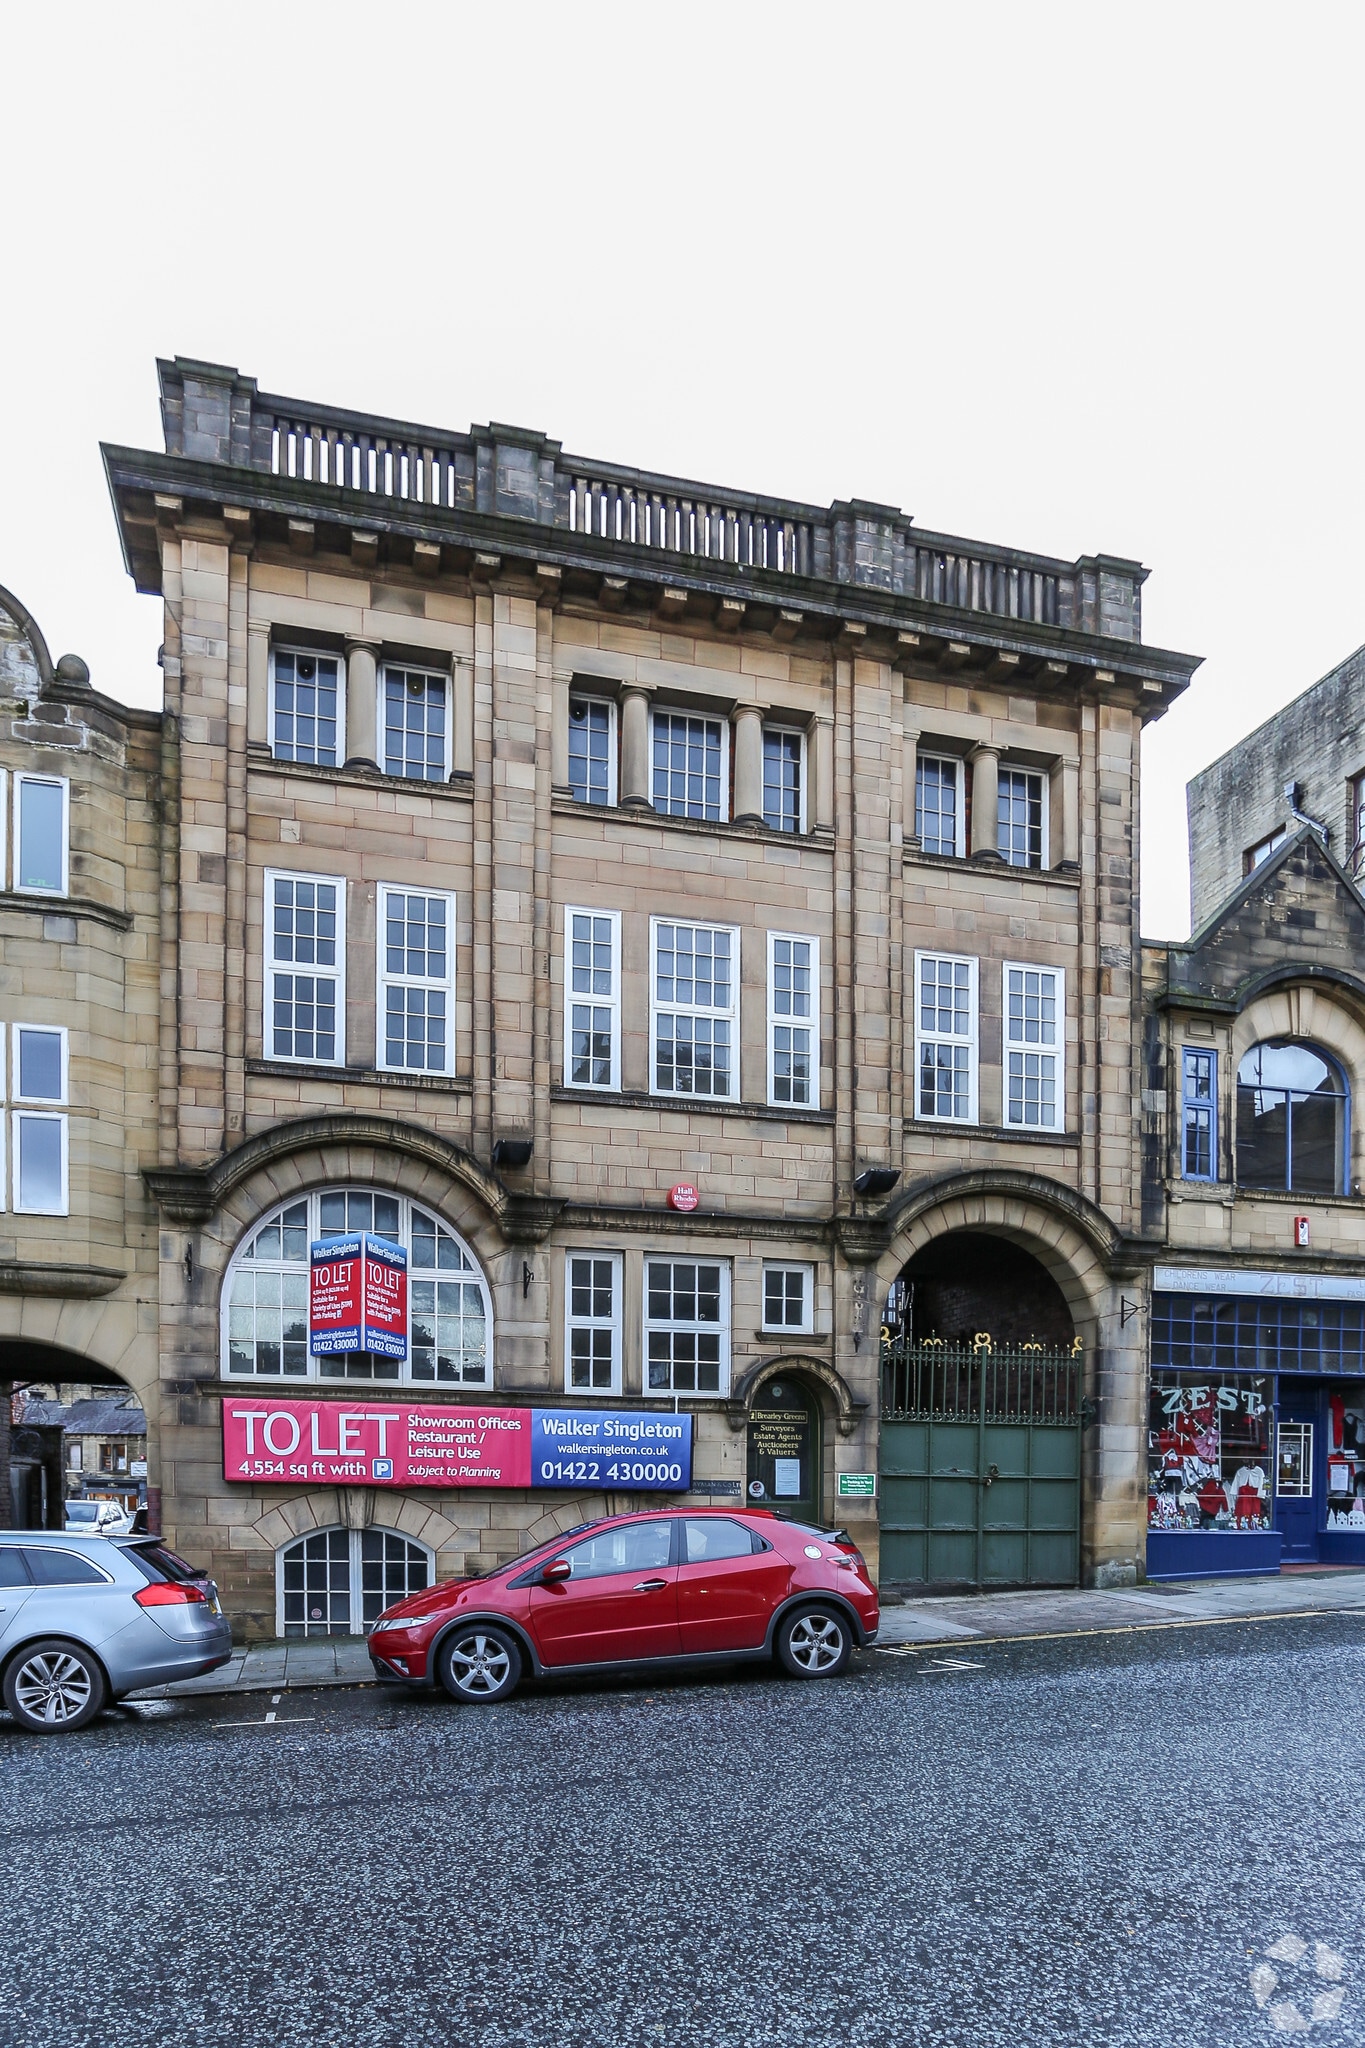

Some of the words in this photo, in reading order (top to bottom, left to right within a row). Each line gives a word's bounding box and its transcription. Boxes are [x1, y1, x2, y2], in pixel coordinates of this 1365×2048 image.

[677, 1186, 693, 1194] Hall
[673, 1194, 698, 1202] Rhodes
[313, 1267, 331, 1287] TO
[333, 1262, 354, 1284] LET
[367, 1261, 382, 1284] TO
[384, 1268, 401, 1291] LET
[1164, 1269, 1208, 1280] CHILDRENS
[1214, 1273, 1236, 1281] WEAR
[1172, 1281, 1199, 1290] DANCE
[1205, 1283, 1227, 1292] WEAR
[1259, 1274, 1324, 1298] ZEST
[313, 1341, 332, 1352] 01422
[333, 1338, 358, 1350] 430000
[367, 1338, 385, 1351] 01422
[384, 1343, 405, 1356] 430000
[1161, 1386, 1262, 1416] ZEST
[407, 1414, 475, 1429] Showroom
[477, 1416, 522, 1430] Offices
[757, 1412, 782, 1421] Brearley
[783, 1412, 806, 1421] Greens
[232, 1411, 301, 1456] TO
[311, 1412, 400, 1457] LET
[542, 1418, 600, 1436] Walker
[603, 1420, 682, 1441] Singleton
[760, 1424, 795, 1433] Surveyors
[408, 1430, 477, 1444] Restaurant
[479, 1432, 486, 1444] /
[753, 1432, 775, 1440] Estate
[777, 1433, 803, 1441] Agents
[408, 1445, 455, 1458] Leisure
[457, 1446, 481, 1459] Use
[557, 1443, 669, 1457] walkersingleton.co.uk
[757, 1441, 799, 1449] Auctioneers
[766, 1448, 797, 1456] Valuers.
[238, 1460, 285, 1477] 4,554
[289, 1464, 309, 1479] sq
[311, 1461, 326, 1475] ft
[329, 1461, 367, 1476] with
[407, 1465, 444, 1478] Subject
[446, 1466, 457, 1476] to
[459, 1466, 501, 1480] Planning
[541, 1461, 600, 1480] 01422
[606, 1462, 682, 1482] 430000
